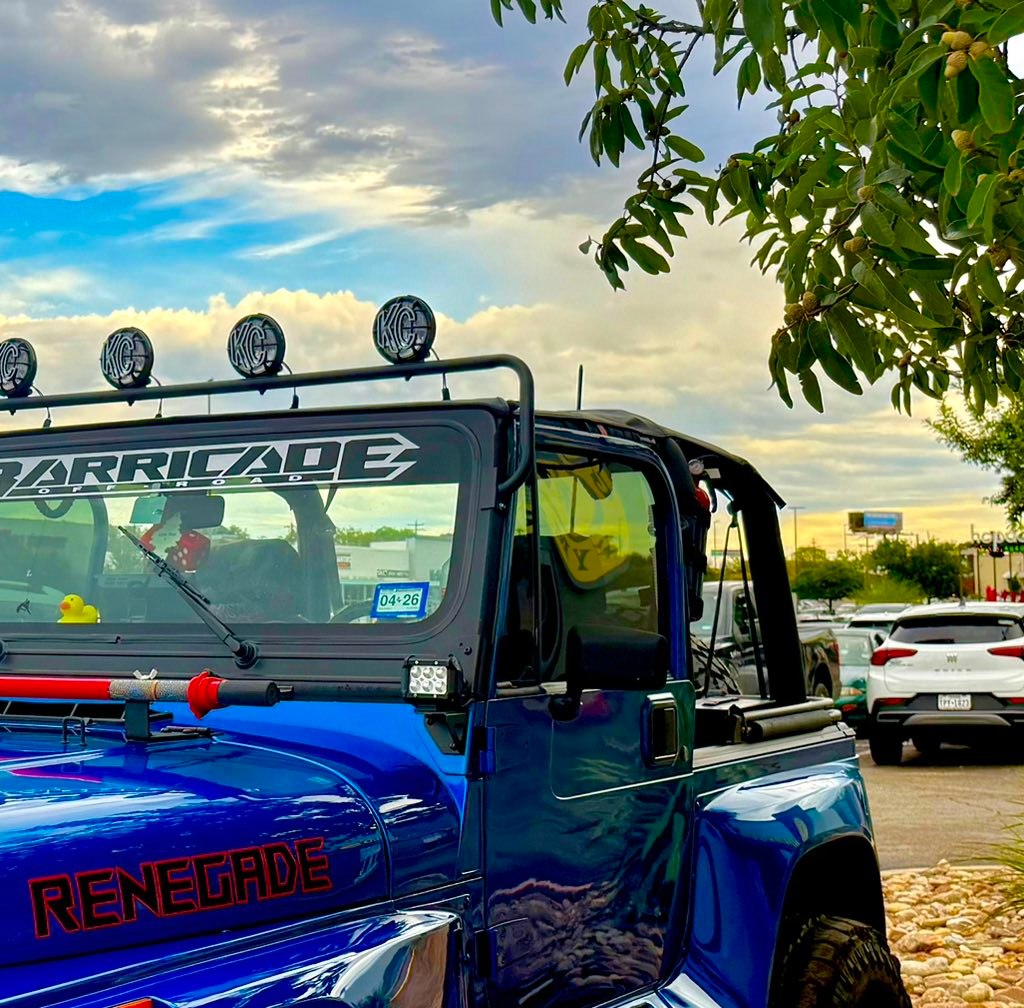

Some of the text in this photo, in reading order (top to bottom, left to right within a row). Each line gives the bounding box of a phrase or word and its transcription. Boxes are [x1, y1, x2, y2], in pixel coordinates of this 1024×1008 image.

[230, 323, 267, 370] KC
[377, 303, 416, 354] KC
[103, 333, 135, 379] KC
[380, 593, 420, 607] 04 26
[28, 837, 333, 939] RENEGADE
